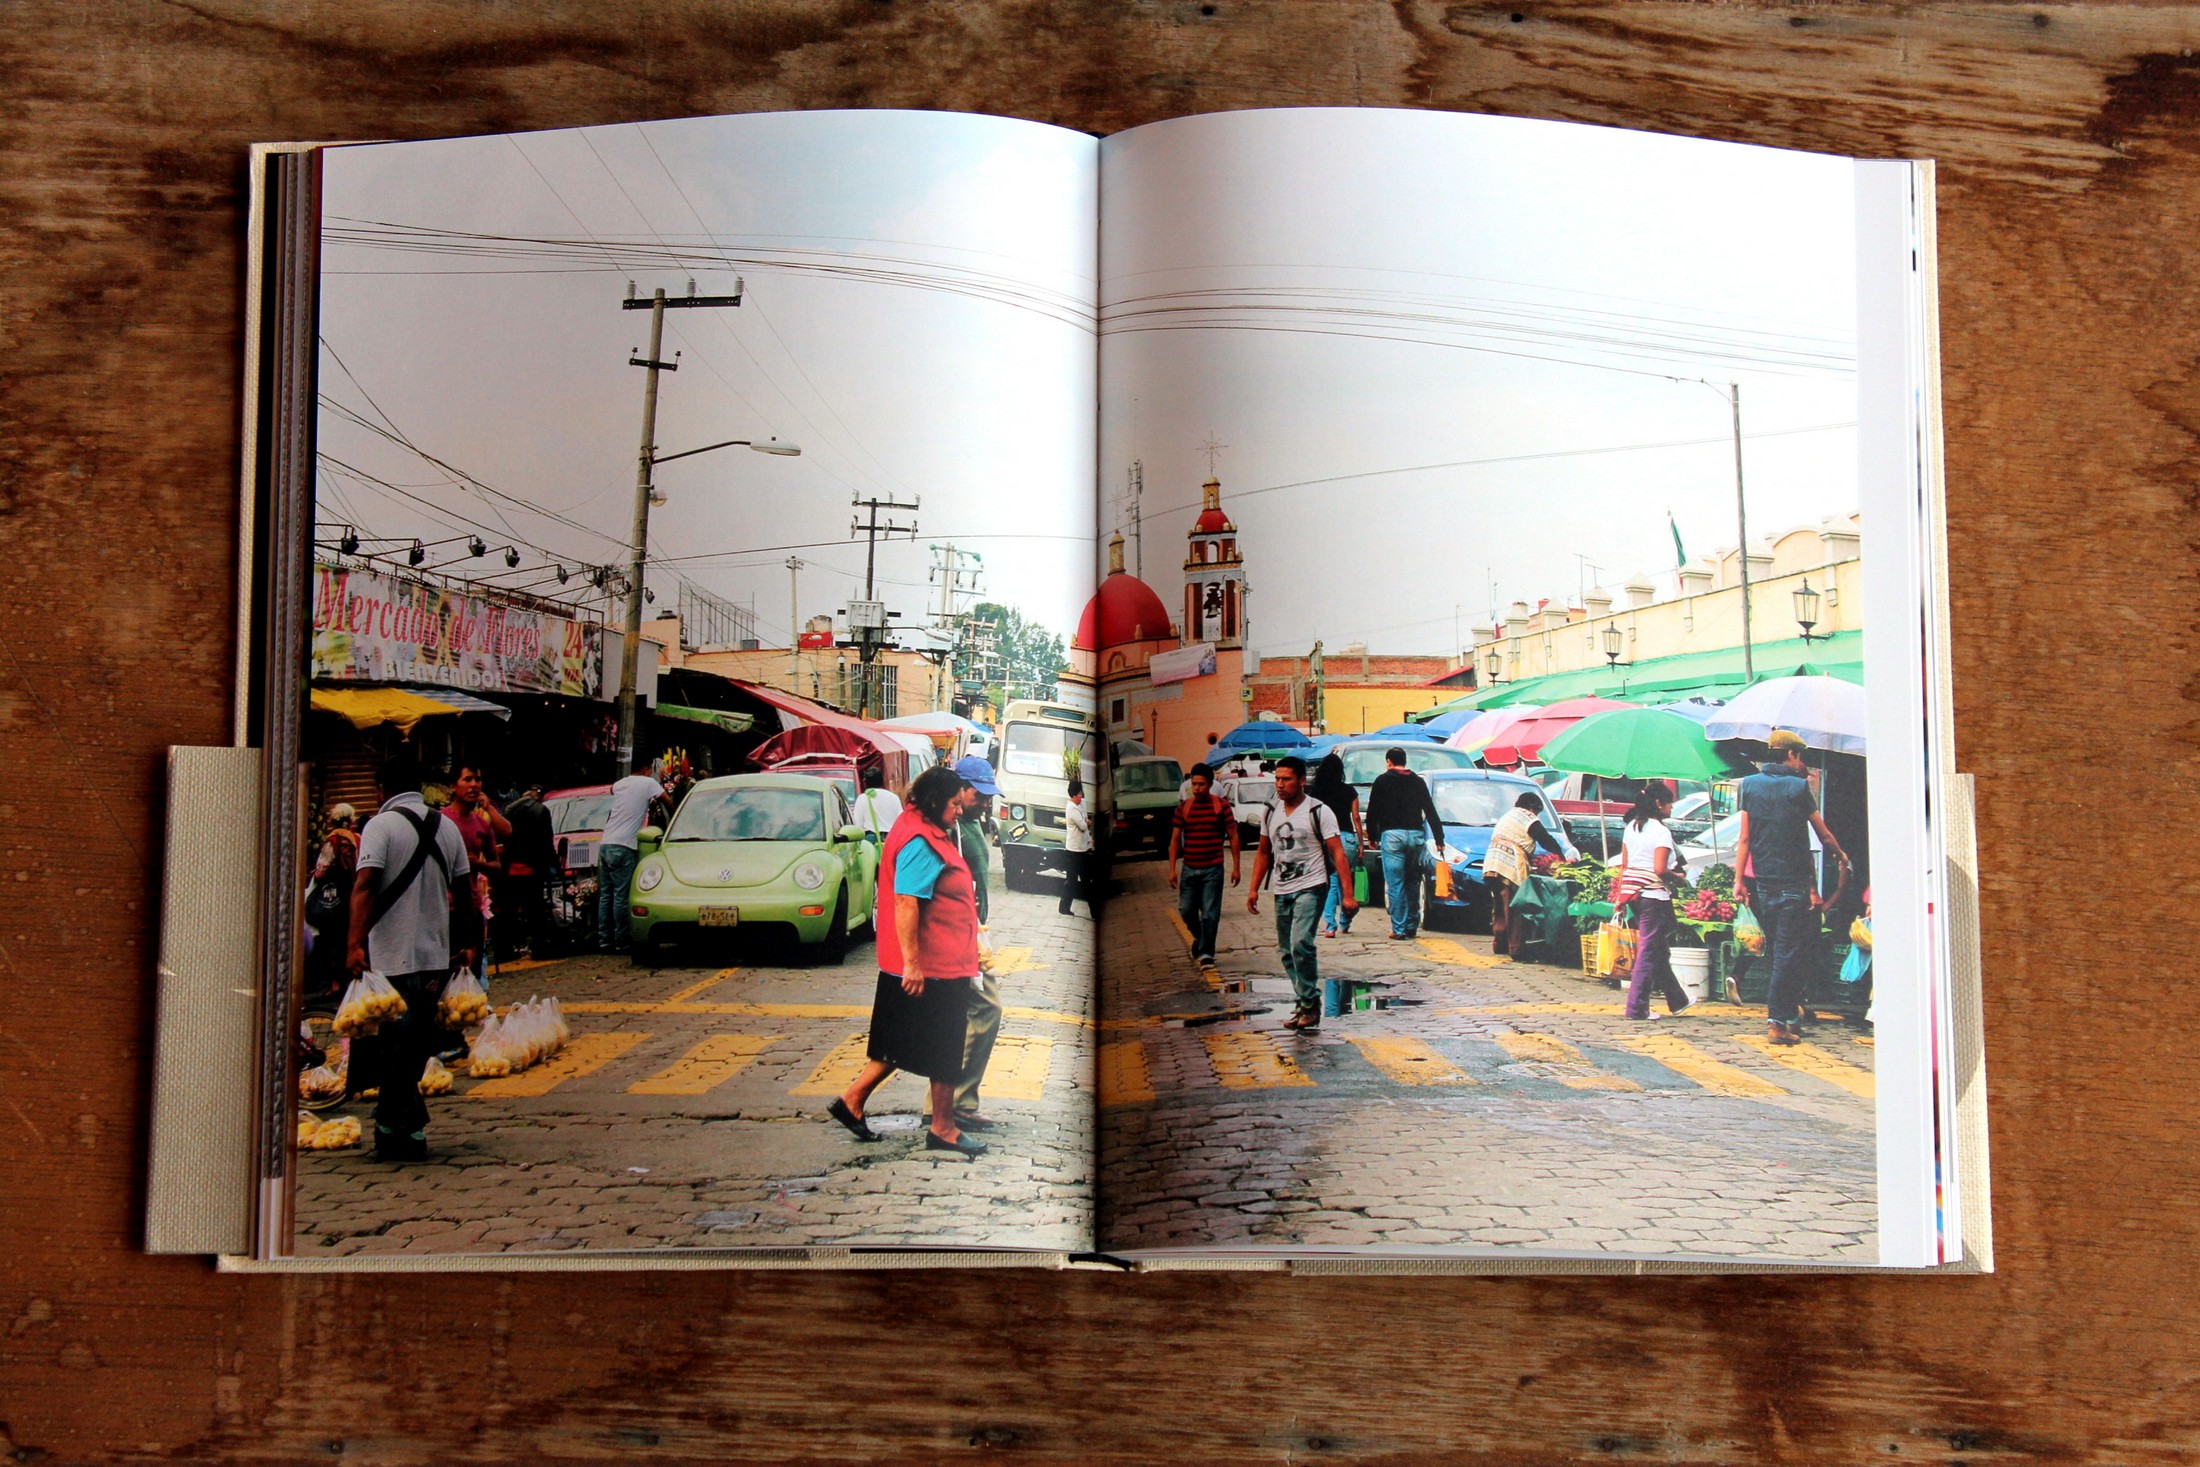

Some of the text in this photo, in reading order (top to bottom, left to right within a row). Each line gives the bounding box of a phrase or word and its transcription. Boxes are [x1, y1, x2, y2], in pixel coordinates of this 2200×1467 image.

[313, 568, 540, 659] Mercado de Flores
[563, 620, 583, 659] 24
